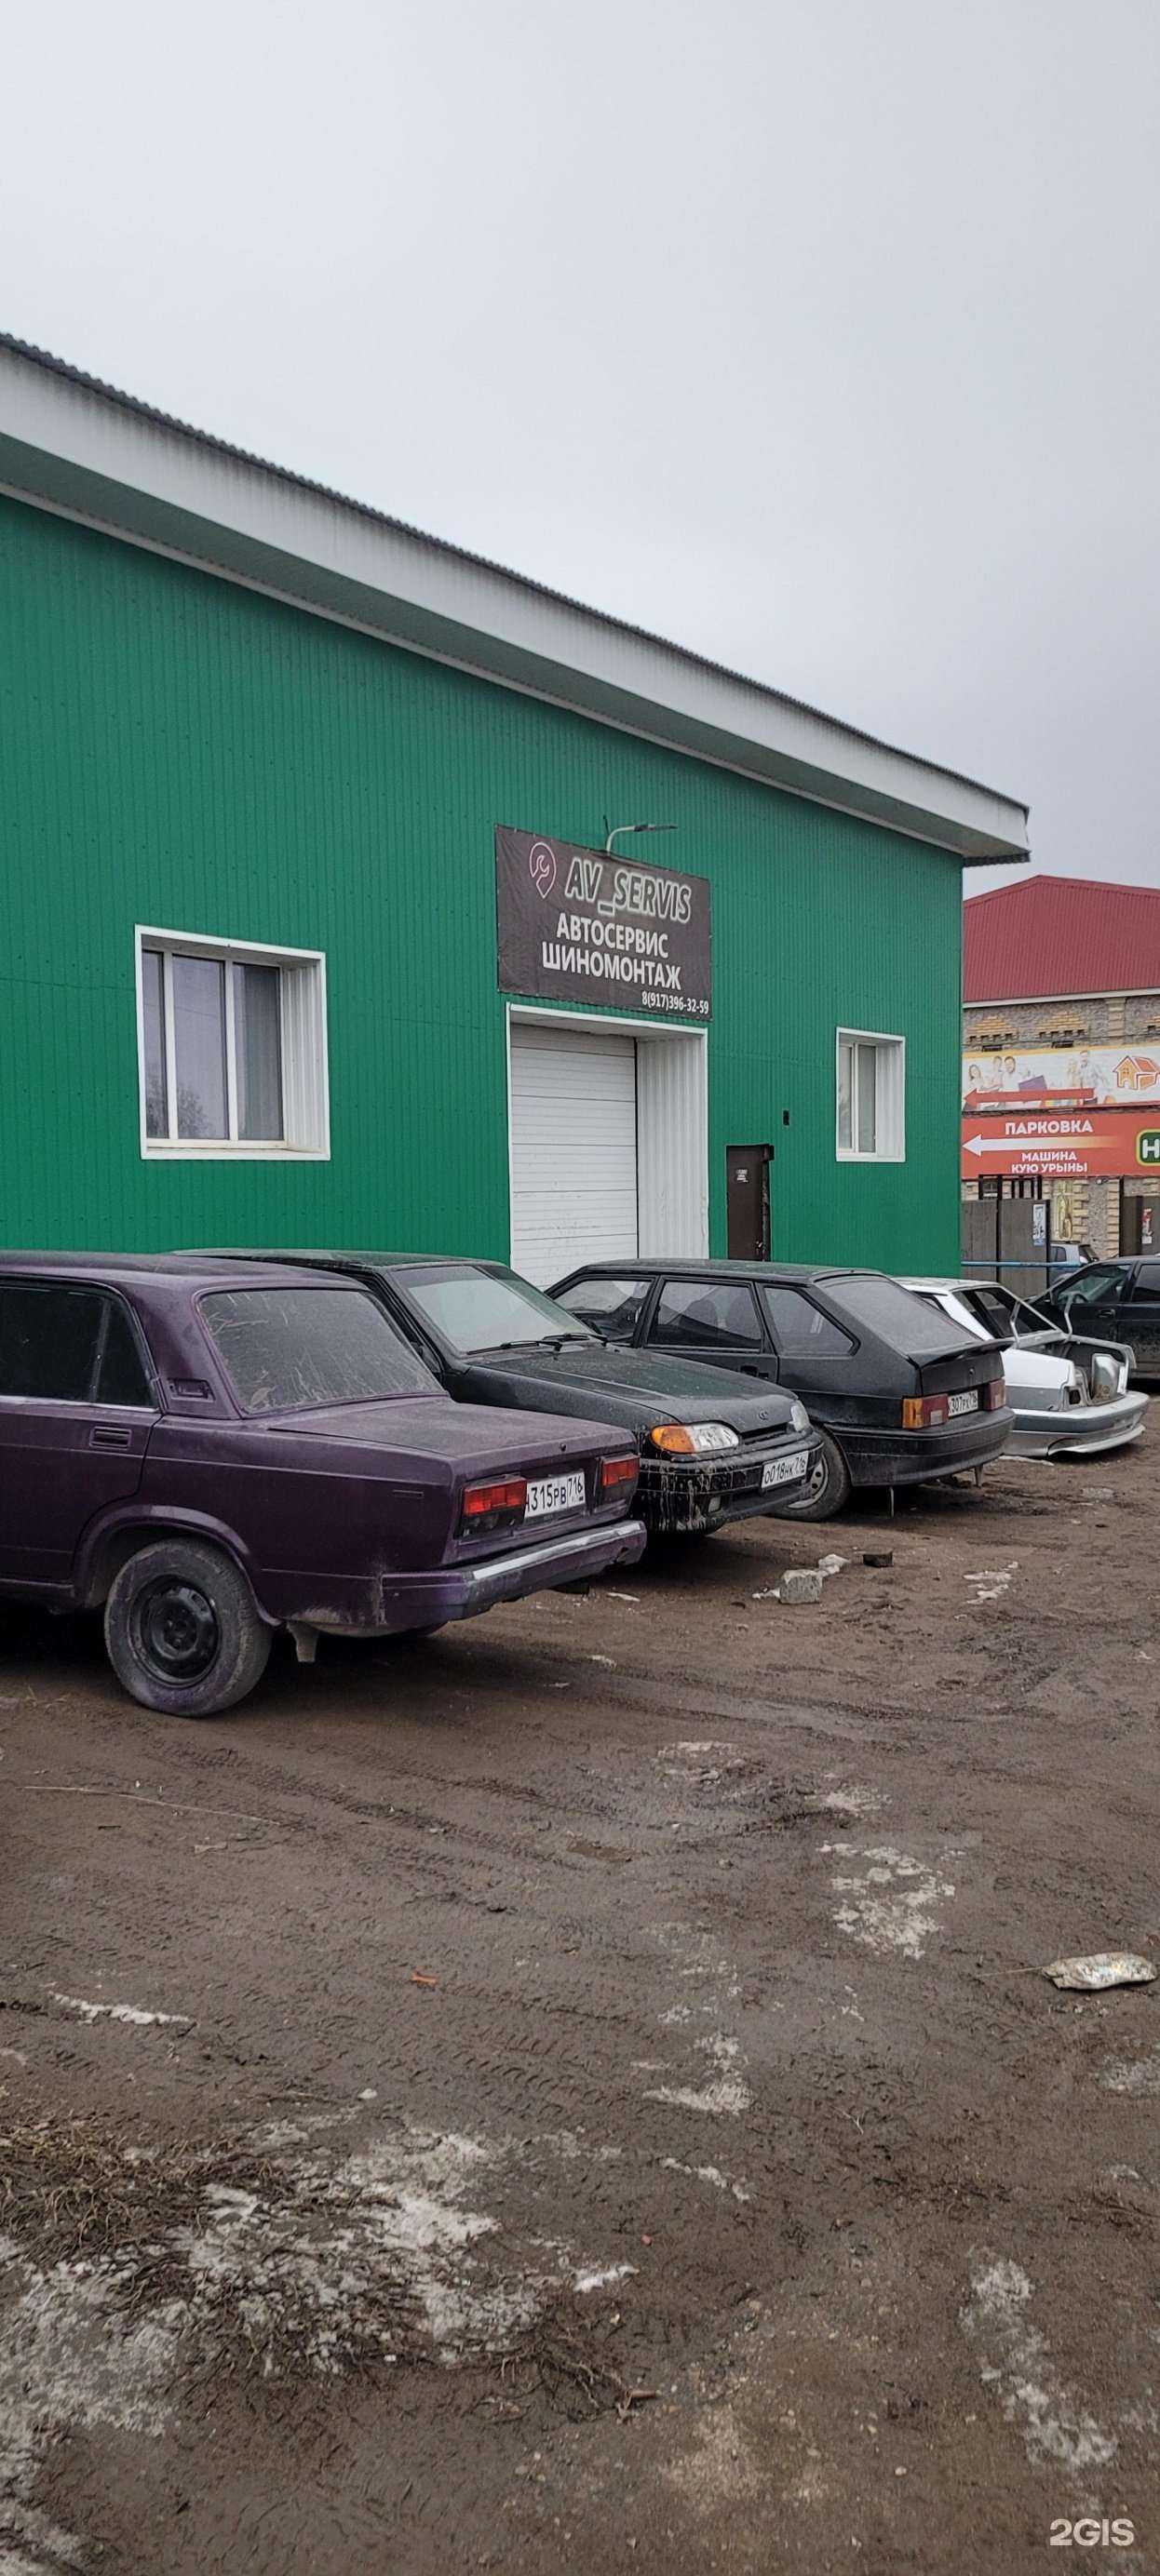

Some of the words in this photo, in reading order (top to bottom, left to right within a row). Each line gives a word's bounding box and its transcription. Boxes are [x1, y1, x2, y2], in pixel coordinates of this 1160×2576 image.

[564, 856, 693, 923] AV_SERVIS
[556, 912, 669, 959] АВТОСЕРВИС
[542, 941, 681, 990] ШИНОМОНТАЖ
[641, 990, 709, 1014] 8(917)396-32-59
[1005, 1120, 1093, 1135] ПАРКОВКА
[1021, 1151, 1077, 1161] МАШИНА
[1011, 1164, 1039, 1174] КУЮ
[1041, 1162, 1088, 1173] УРЫНЫ
[568, 1476, 584, 1496] 716
